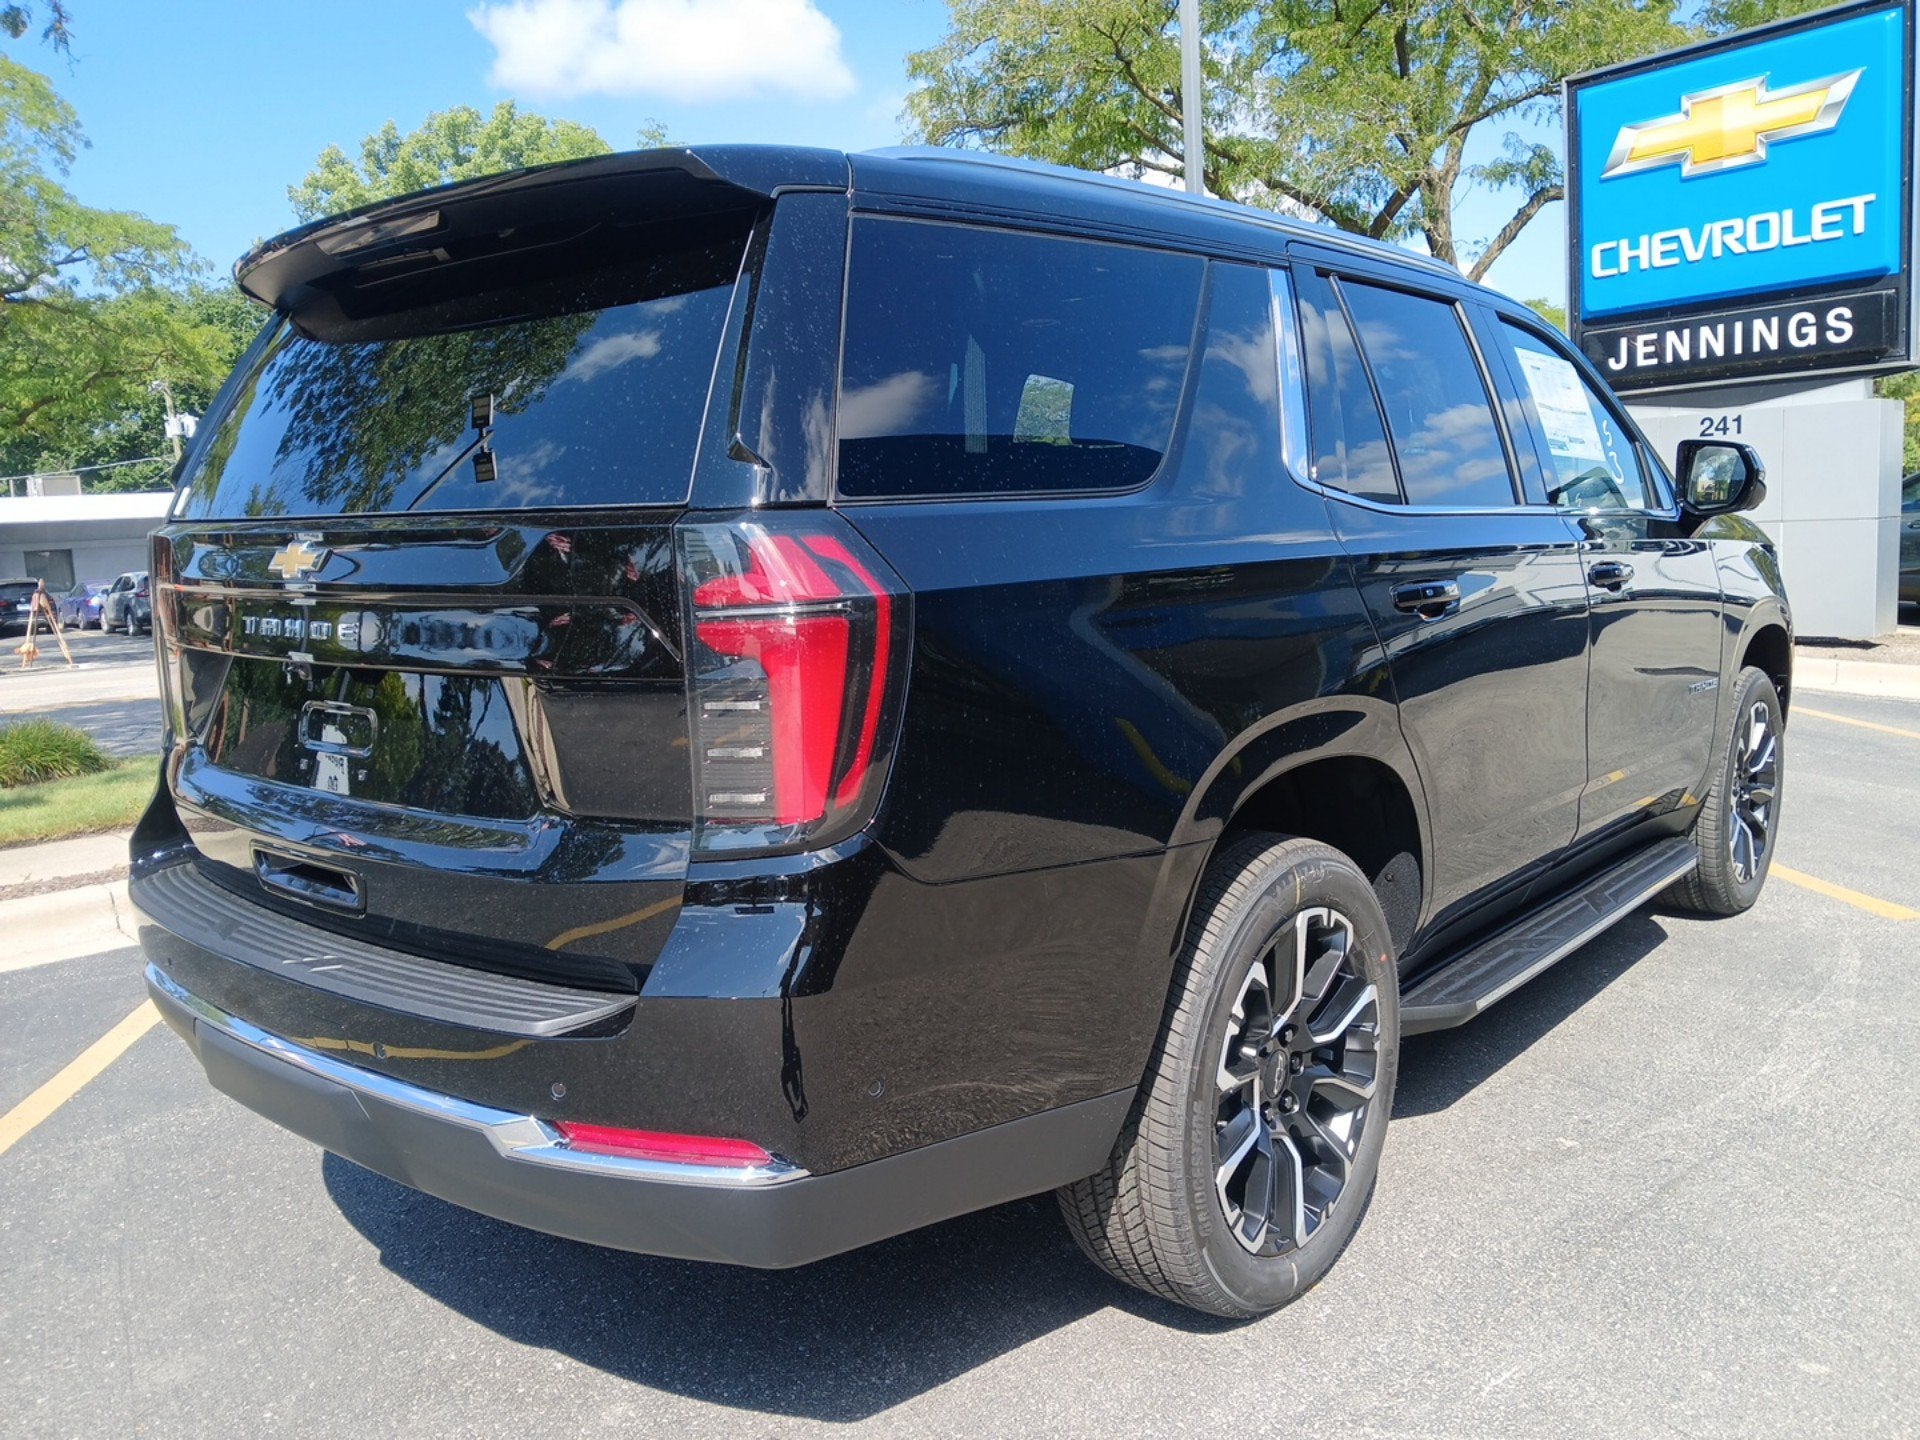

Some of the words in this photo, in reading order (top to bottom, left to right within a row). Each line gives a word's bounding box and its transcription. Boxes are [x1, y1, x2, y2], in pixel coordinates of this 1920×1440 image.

[1591, 193, 1876, 278] CHEVROLET
[1607, 306, 1854, 370] JENNINGS
[1699, 415, 1743, 437] 241
[242, 616, 360, 642] TAHOE
